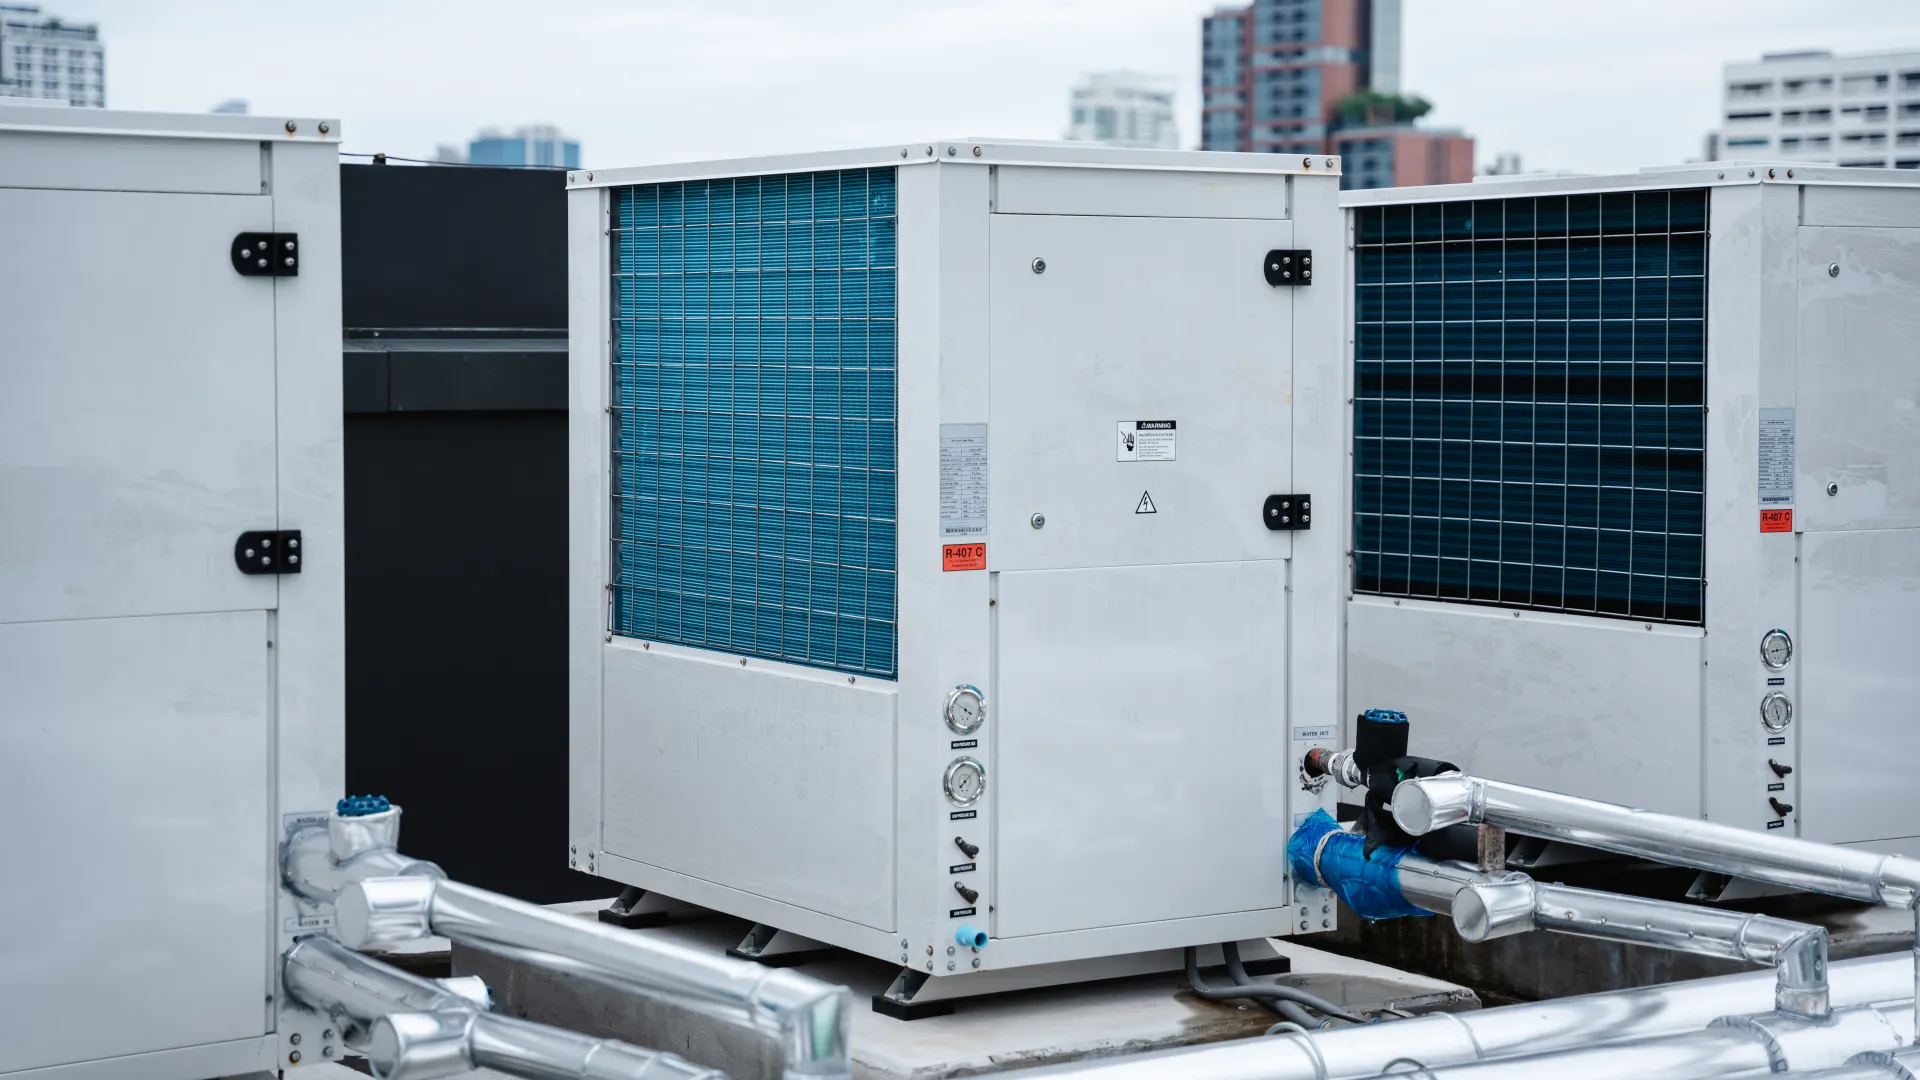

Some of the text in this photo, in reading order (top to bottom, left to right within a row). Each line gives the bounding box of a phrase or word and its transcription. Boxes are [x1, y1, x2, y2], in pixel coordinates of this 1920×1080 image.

[1762, 511, 1791, 522] R-407 C
[945, 546, 983, 559] R-407 C
